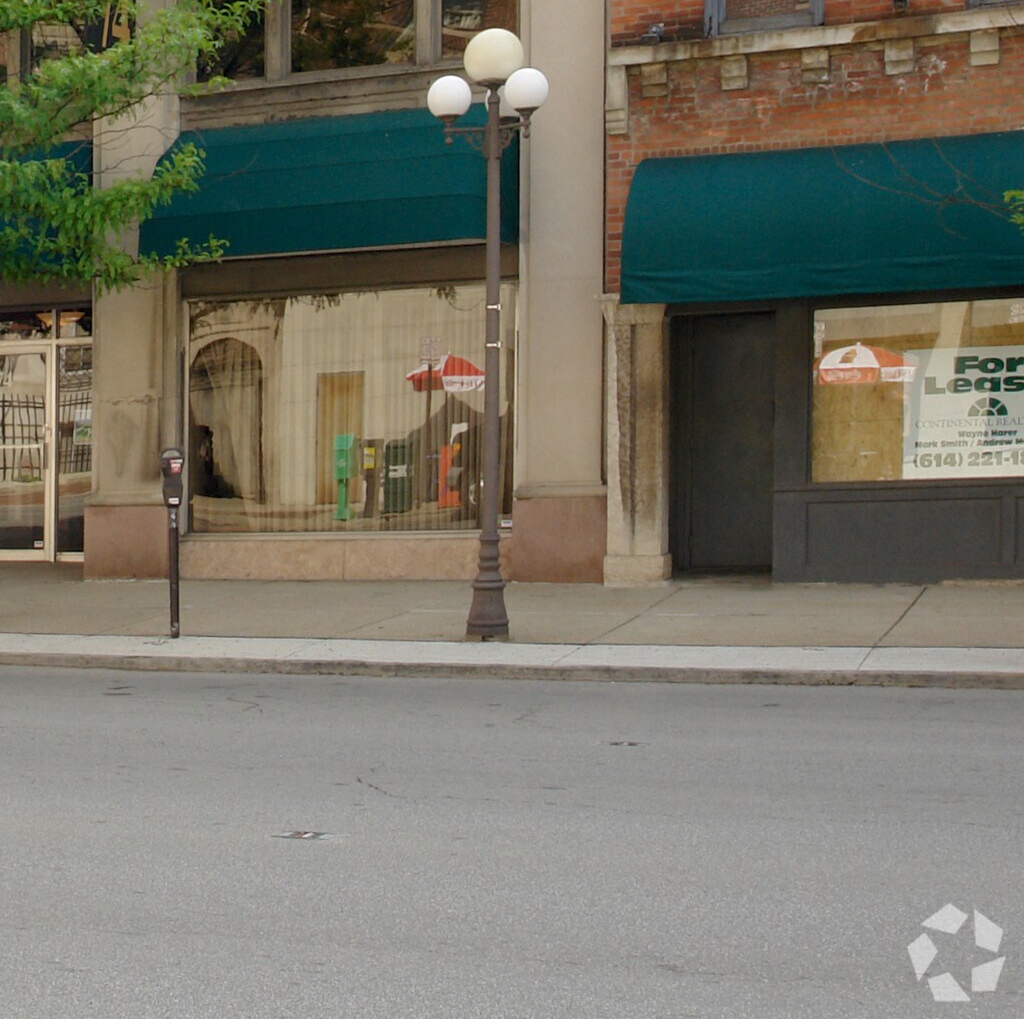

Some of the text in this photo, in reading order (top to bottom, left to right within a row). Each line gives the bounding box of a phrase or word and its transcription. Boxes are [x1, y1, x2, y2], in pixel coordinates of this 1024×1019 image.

[954, 356, 1024, 374] For
[915, 416, 1024, 429] CONTINENTAL REAL
[958, 430, 989, 439] Wayne
[915, 441, 938, 449] Mark
[941, 439, 969, 448] Smith
[977, 438, 1013, 447] Andrew
[913, 452, 963, 468] (614)
